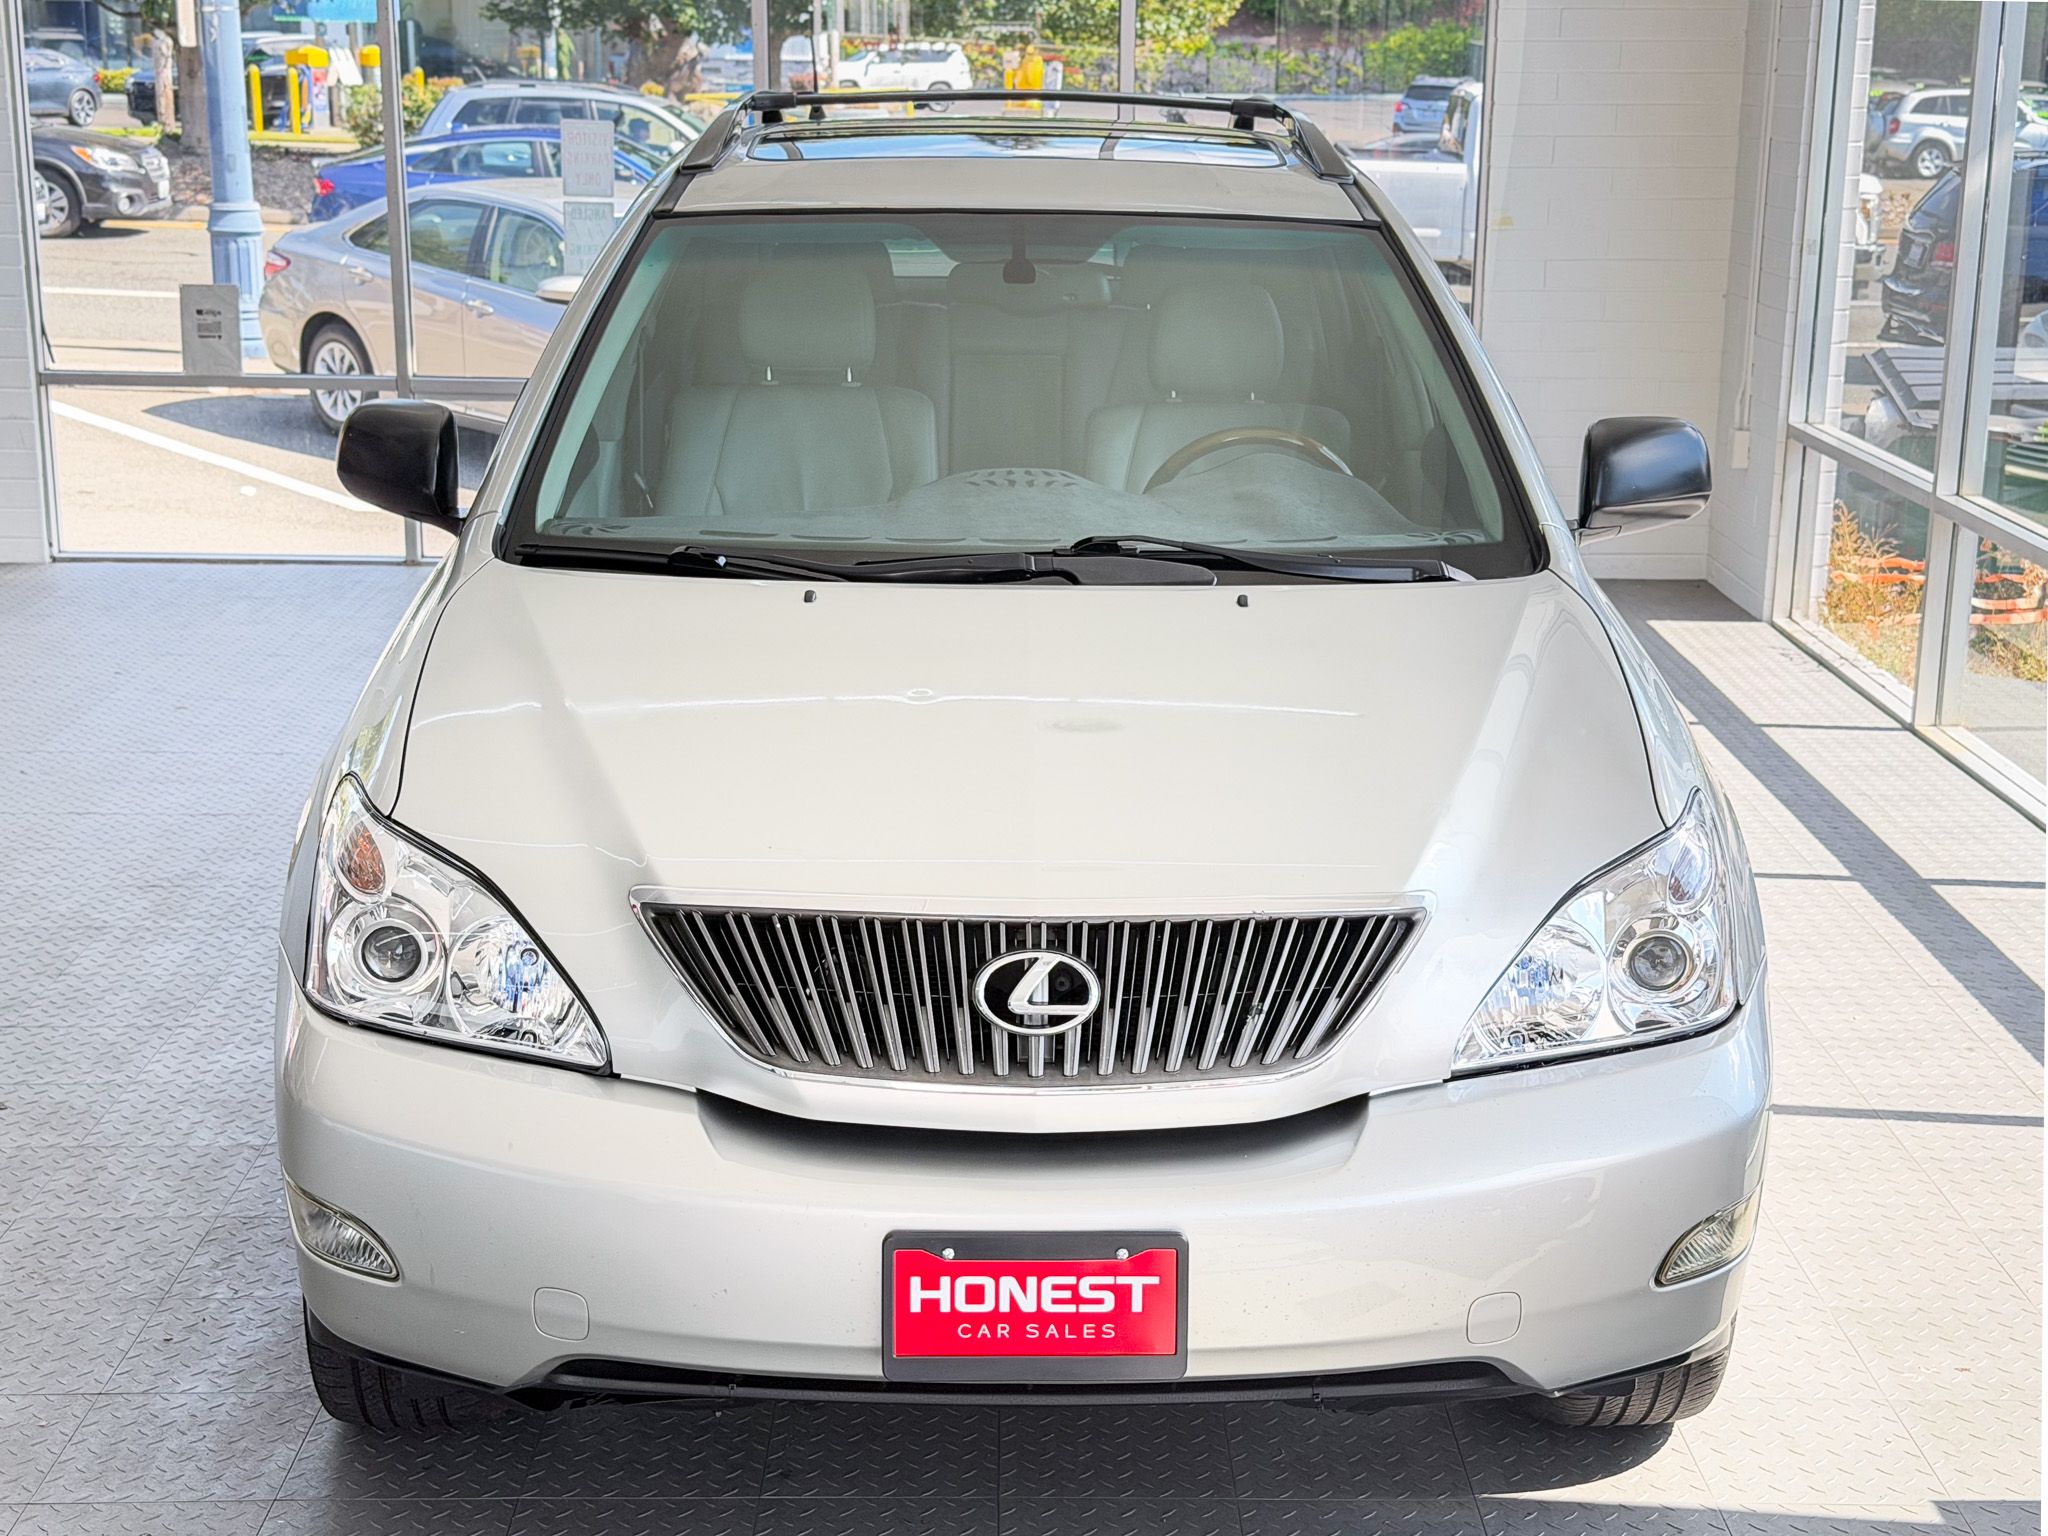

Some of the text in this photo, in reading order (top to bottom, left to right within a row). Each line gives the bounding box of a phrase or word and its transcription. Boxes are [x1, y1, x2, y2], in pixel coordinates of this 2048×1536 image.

[909, 1275, 1160, 1313] HONEST
[957, 1323, 1116, 1339] CAR SALES
